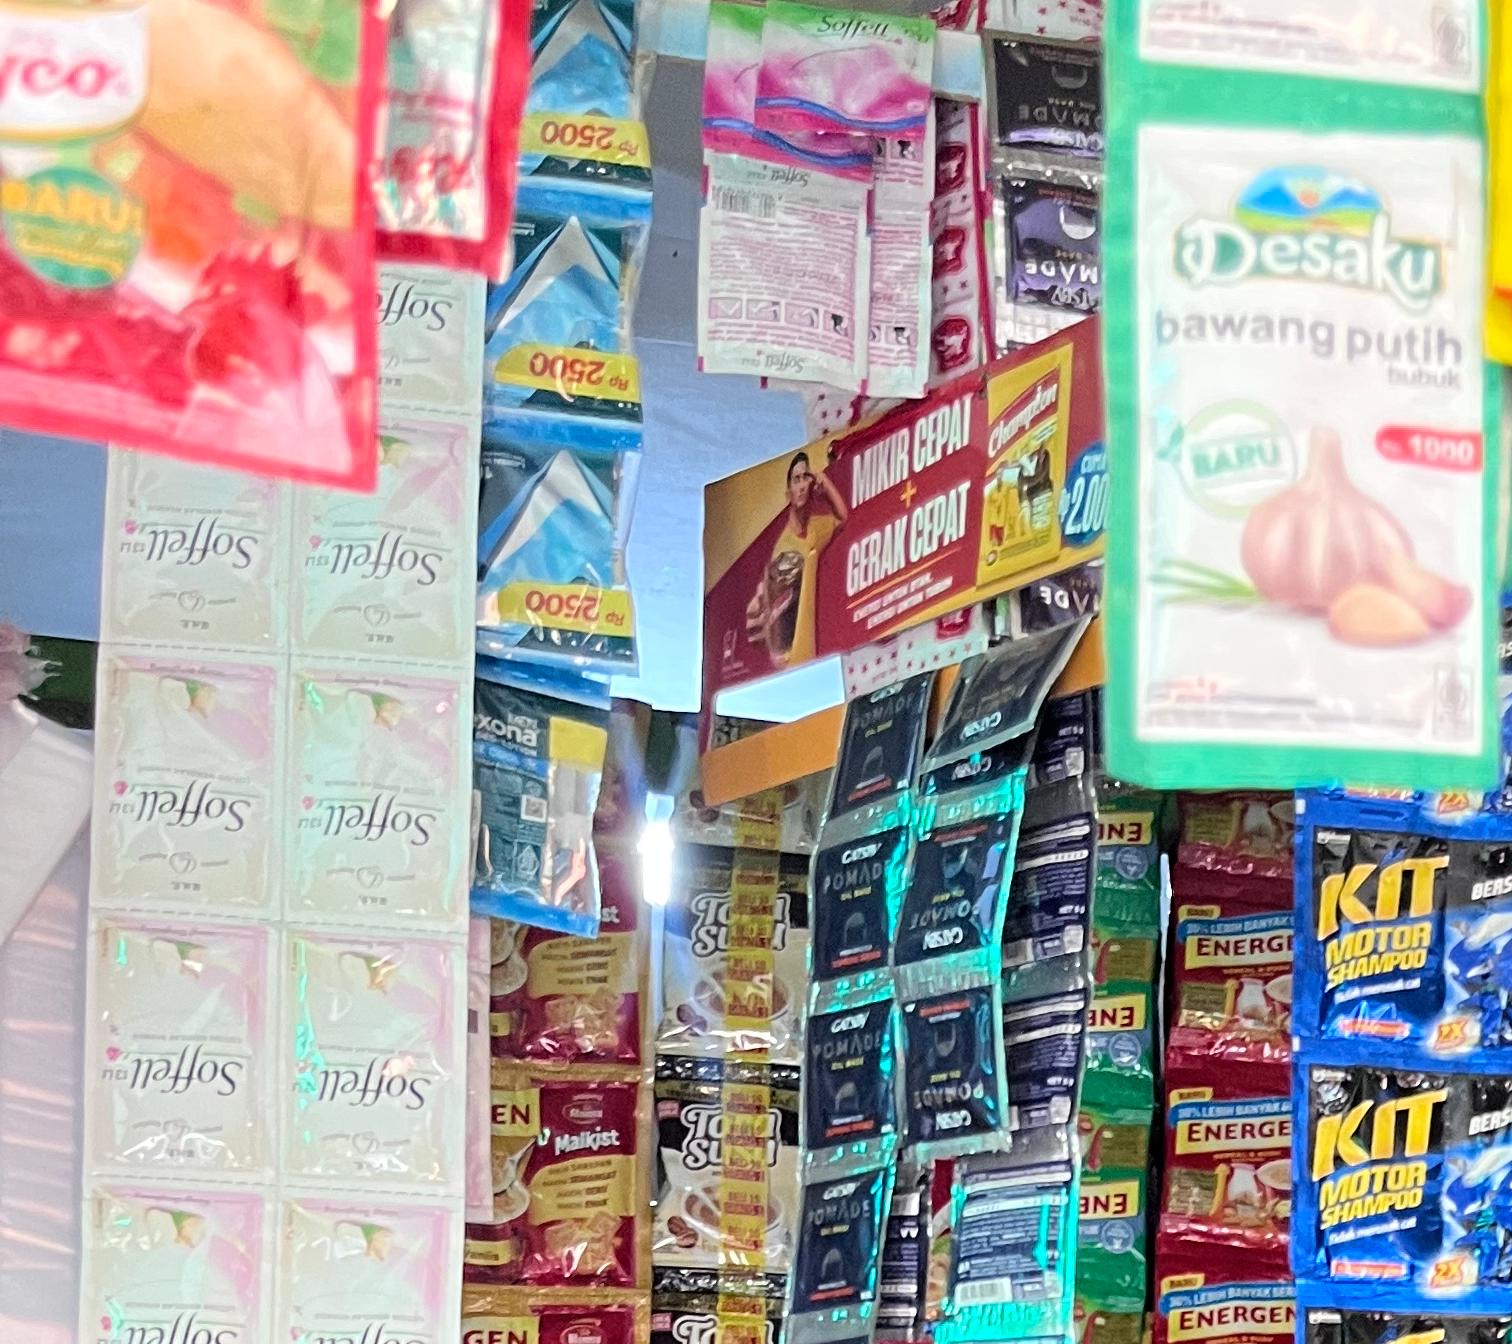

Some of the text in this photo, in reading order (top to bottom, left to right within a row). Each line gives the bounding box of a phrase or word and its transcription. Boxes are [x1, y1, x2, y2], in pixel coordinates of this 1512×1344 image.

[540, 121, 613, 148] 2500
[1179, 226, 1441, 302] Desaku
[380, 282, 452, 331] Soff
[1156, 308, 1463, 369] bawang putih
[529, 352, 605, 383] 2500
[852, 397, 972, 508] MIKIR CEPAT
[1409, 437, 1474, 463] 1000
[147, 517, 260, 571] Soffell
[331, 530, 444, 585] Soffell
[846, 482, 971, 596] GERAK CEPAT
[526, 589, 600, 619] 2500
[135, 779, 251, 836] Soffell
[325, 792, 436, 847] Soffell
[1318, 856, 1449, 941] KIT
[1327, 921, 1432, 966] MOTOR
[1326, 951, 1426, 992] SHAMPOO
[130, 1042, 243, 1096] Soffell
[318, 1055, 430, 1111] Soffell
[554, 1127, 619, 1153] Malkist
[1187, 1120, 1292, 1144] ENERGE
[1313, 1090, 1447, 1180] KIT
[1319, 1163, 1427, 1205] MOTOR
[1320, 1189, 1423, 1230] SHAMPOO
